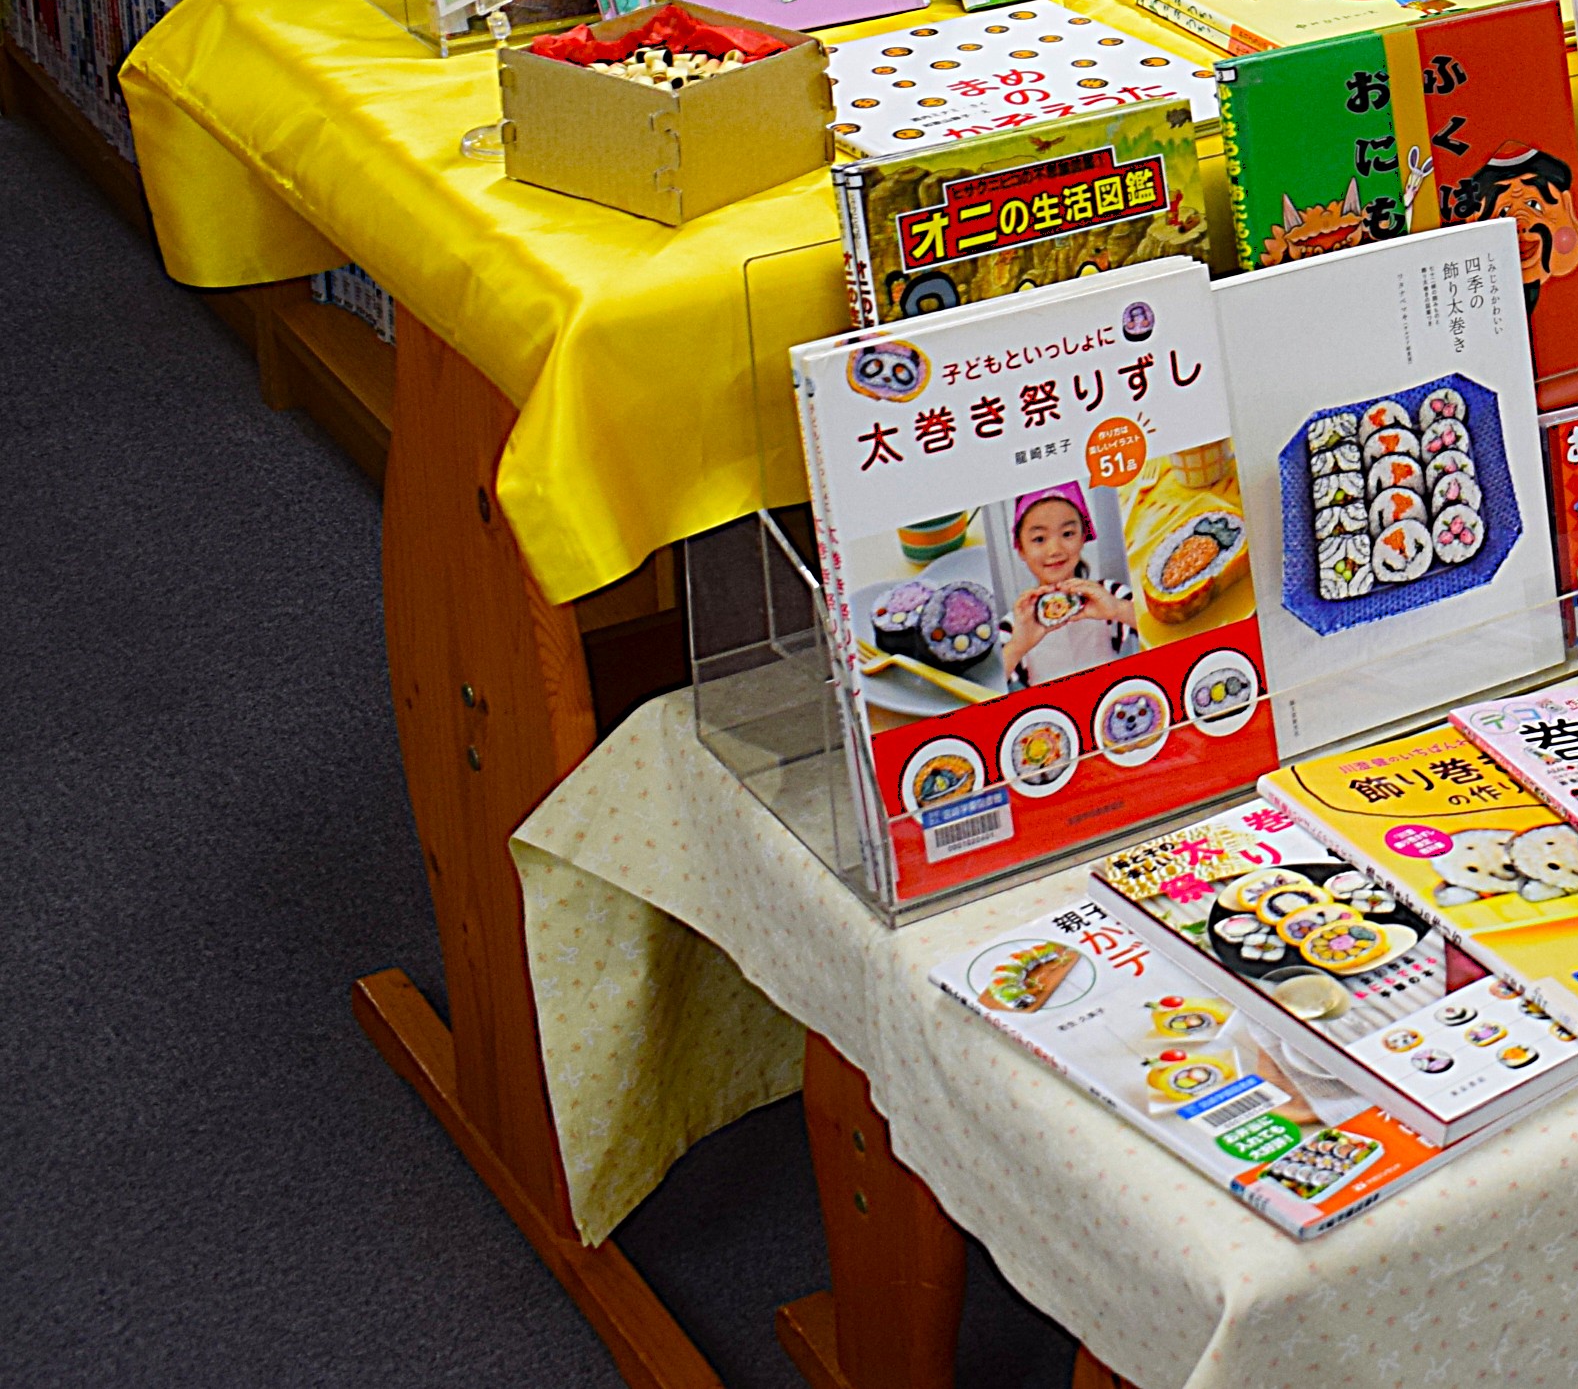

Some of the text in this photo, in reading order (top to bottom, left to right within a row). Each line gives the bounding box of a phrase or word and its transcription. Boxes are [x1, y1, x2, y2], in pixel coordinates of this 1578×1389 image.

[910, 168, 1158, 260] オニの生活図鑑
[1443, 261, 1466, 353] 飾り太巻き
[1465, 257, 1484, 309] 四季の
[858, 349, 1203, 473] 太巻き祭りずし
